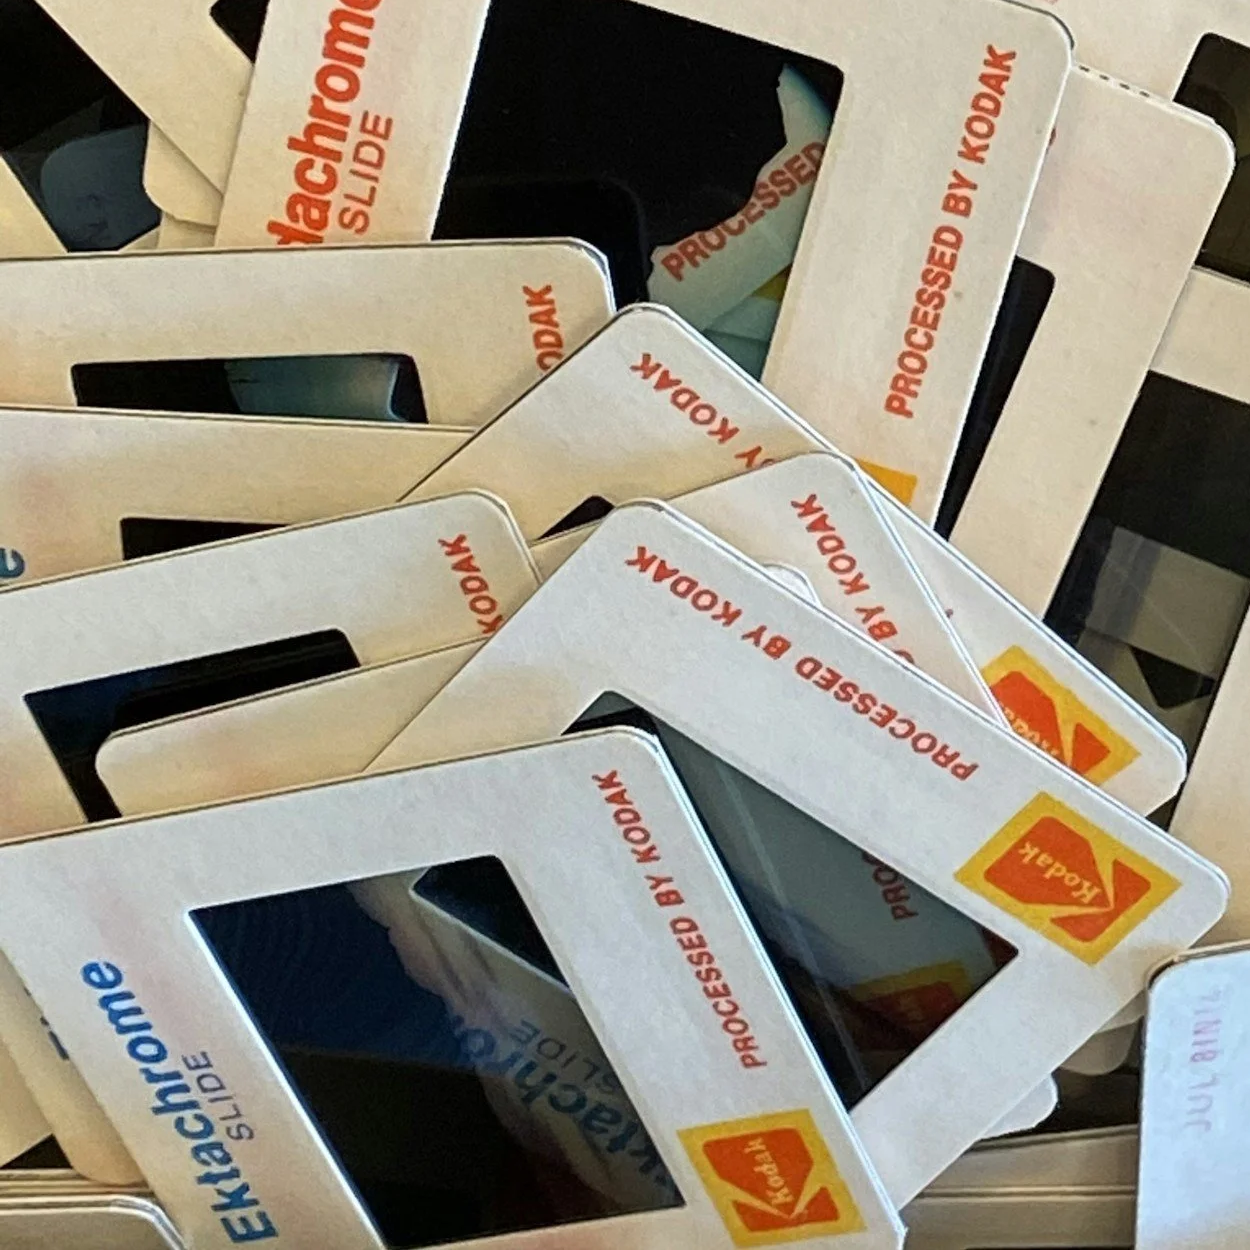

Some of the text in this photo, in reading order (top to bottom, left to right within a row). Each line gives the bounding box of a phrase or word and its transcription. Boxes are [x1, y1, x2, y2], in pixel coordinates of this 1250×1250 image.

[337, 109, 394, 236] SLIDE
[660, 141, 827, 283] PROCESSED
[884, 43, 1017, 420] PROCESSED BY KODAK
[629, 353, 740, 444] KODAK
[437, 533, 504, 635] KODAK
[624, 545, 742, 627] KODAK
[790, 493, 898, 642] BY KODAK
[741, 624, 792, 660] BY
[795, 656, 980, 782] PROCESSED
[591, 768, 768, 1070] PROCESSED BY KODAK
[1018, 841, 1102, 904] Kodak
[81, 960, 280, 1244] Ektachrome
[181, 1050, 255, 1142] SLIDE
[451, 1014, 668, 1188] ktachro
[510, 1018, 618, 1095] SLIDE
[745, 1136, 794, 1207] Kodak
